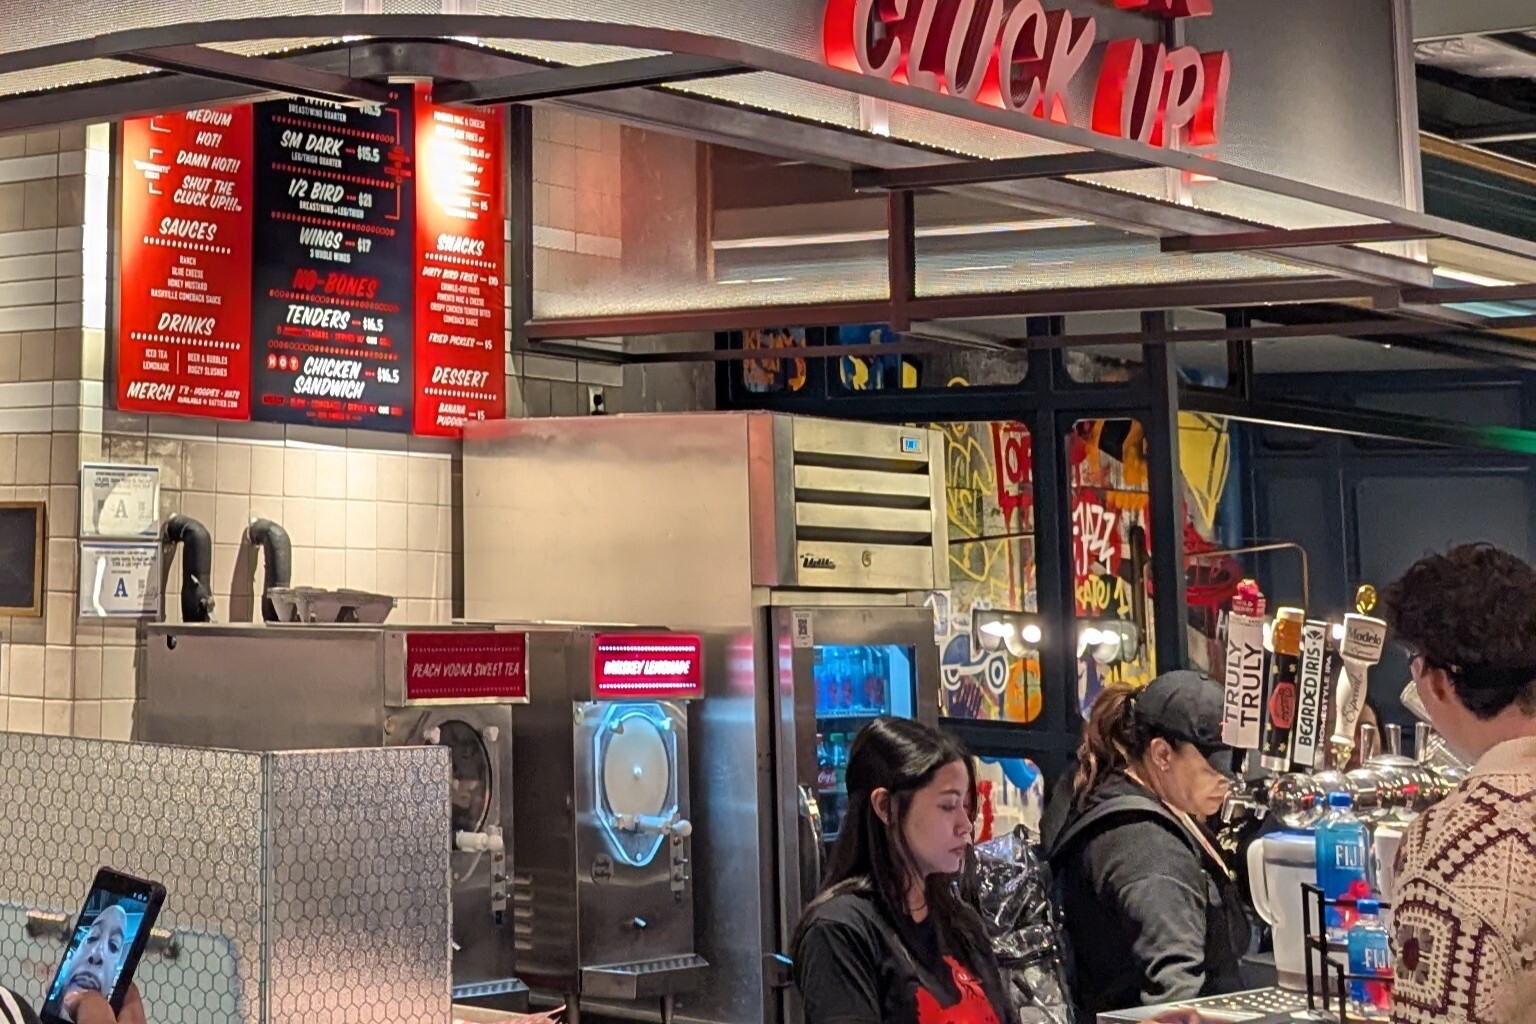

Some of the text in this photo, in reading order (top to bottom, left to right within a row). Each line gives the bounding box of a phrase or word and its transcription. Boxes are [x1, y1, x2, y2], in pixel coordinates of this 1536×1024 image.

[185, 109, 232, 127] MEDIUM
[288, 103, 347, 122] BREAST/WING QUARTER
[1092, 37, 1231, 182] UP!
[468, 117, 486, 129] CHEESE
[195, 131, 222, 148] HOT!
[280, 129, 380, 163] SM DARK $15.5
[176, 150, 241, 174] DAMN HOT!!
[291, 151, 342, 168] LEG/THIGH QUARTER
[182, 175, 235, 196] SHUT THE
[288, 178, 308, 198] 1/2
[310, 181, 344, 203] BIRD
[173, 189, 210, 208] CLUCK
[159, 216, 218, 241] SAUCES
[299, 226, 372, 253] WINGS $17
[436, 233, 485, 256] SNACKS
[179, 255, 196, 265] RANCH
[171, 266, 204, 279] BLUE CHEESE
[422, 265, 442, 278] DIRTY
[442, 268, 459, 280] BIRD
[459, 271, 479, 283] FRIES
[167, 278, 208, 291] HONEY MUSTARD
[293, 268, 379, 299] NO-BONES
[150, 288, 222, 305] NASHVILLE COMEBACK SAUCE
[286, 304, 351, 330] TENDERS
[430, 302, 445, 312] CRISPY
[445, 304, 463, 314] CHICKEN
[158, 312, 216, 336] DRINKS
[428, 332, 449, 344] FRIED
[449, 335, 476, 347] PICKLES
[145, 348, 168, 359] ICED TEA
[187, 352, 200, 362] BEER
[206, 354, 228, 365] BUBBLES
[142, 360, 169, 372] LEMONADE
[303, 356, 362, 380] CHICKEN
[293, 375, 366, 399] SANDWICH
[431, 366, 490, 388] DESSERT
[126, 381, 176, 401] MERCH
[438, 402, 466, 415] BANANA
[114, 499, 128, 518] A
[114, 577, 128, 598] A
[1348, 627, 1381, 646] Modelo
[412, 662, 520, 678] PEACH VODKA SWEET TEA
[1225, 639, 1242, 723] TRULY
[1240, 643, 1262, 727] TRULY
[1298, 647, 1321, 747] BEARDED IRIS
[1318, 655, 1332, 747] HOMESTYLE IPA
[1335, 844, 1365, 867] FIJI
